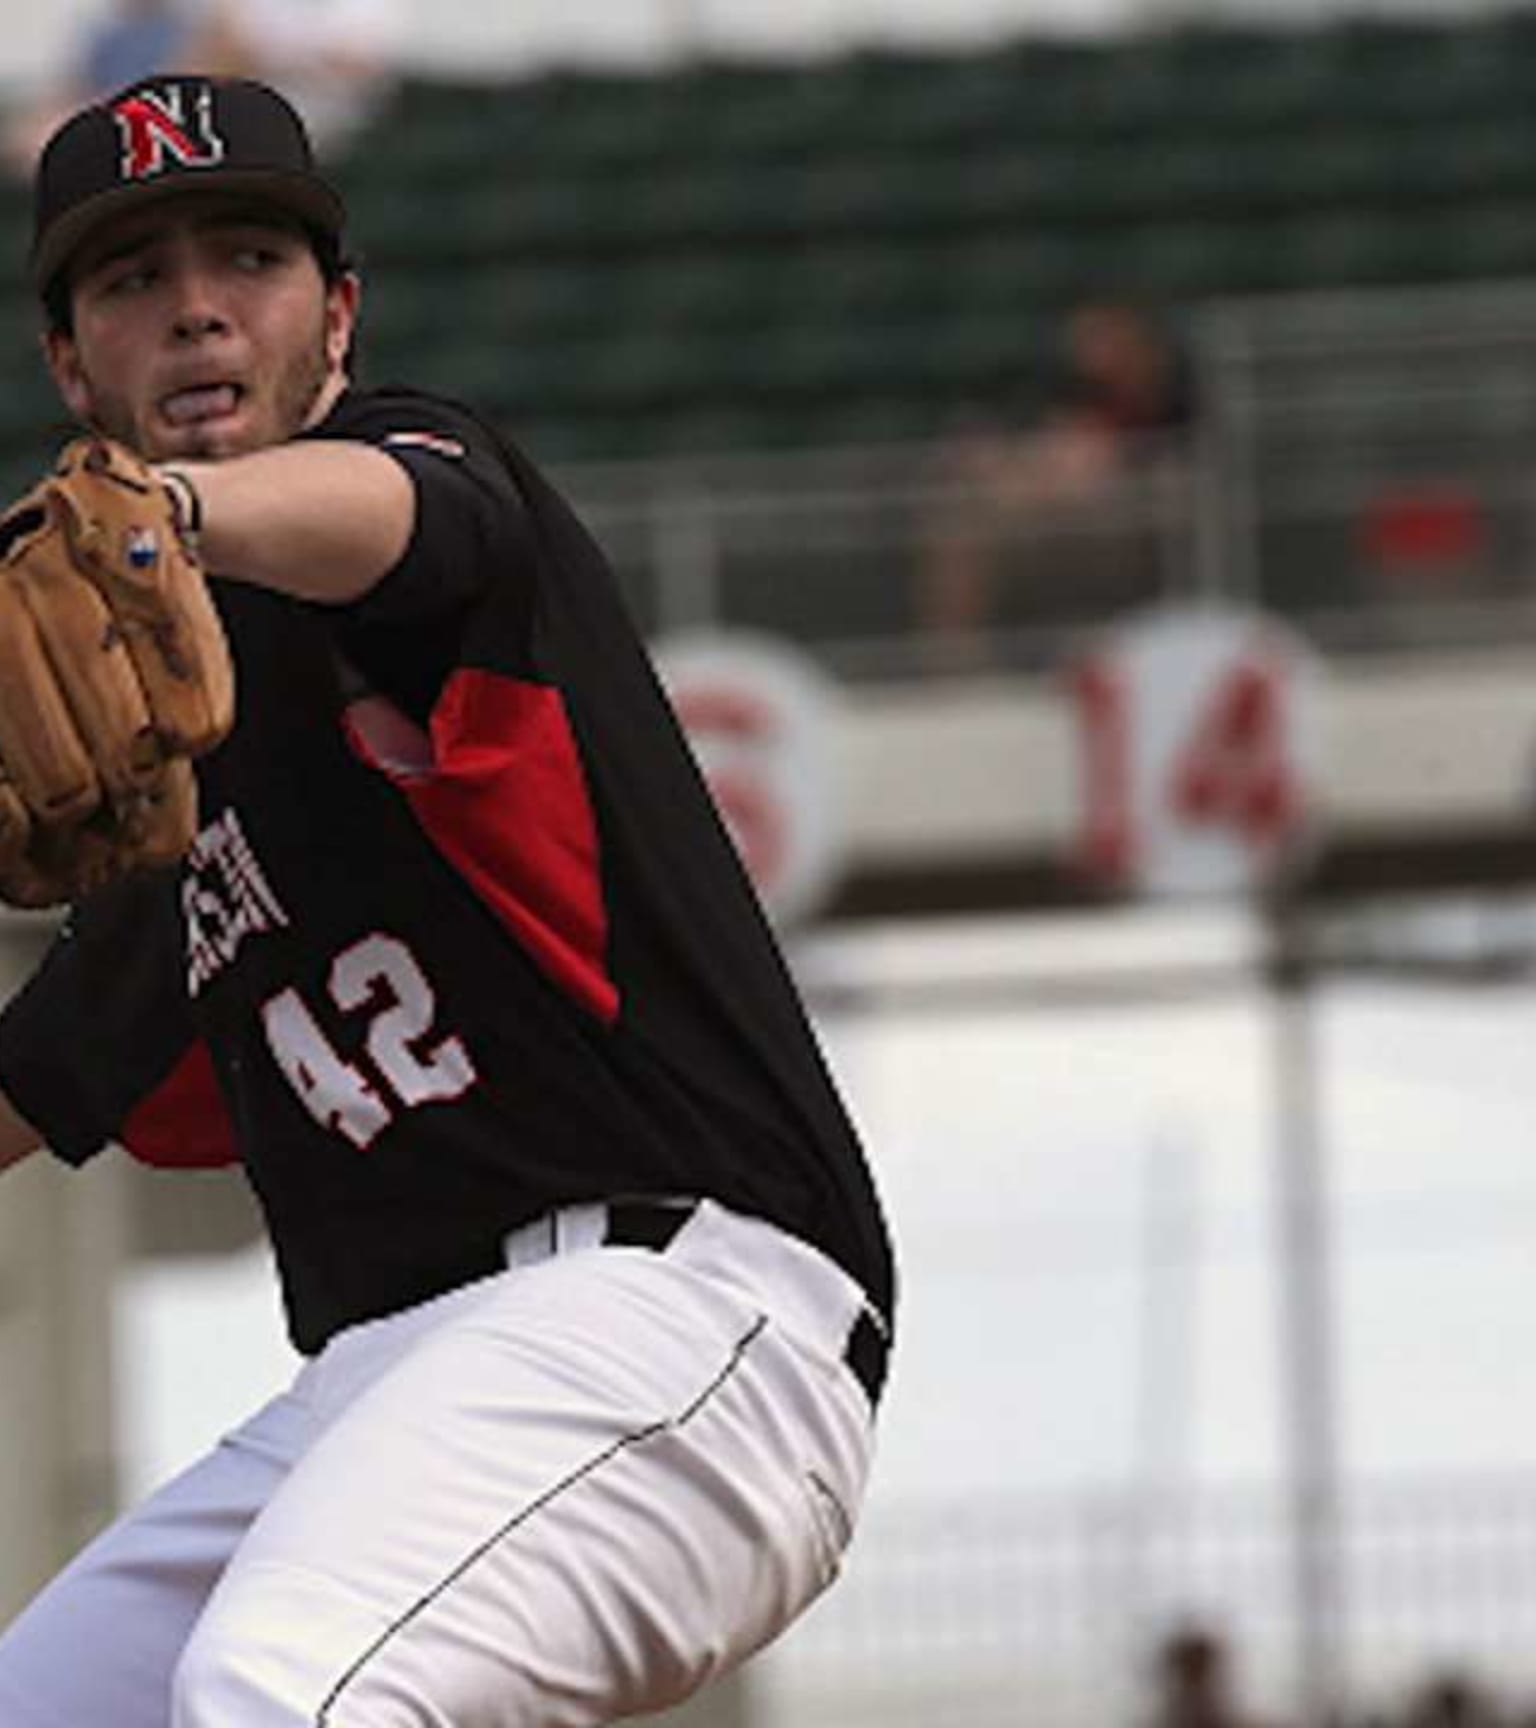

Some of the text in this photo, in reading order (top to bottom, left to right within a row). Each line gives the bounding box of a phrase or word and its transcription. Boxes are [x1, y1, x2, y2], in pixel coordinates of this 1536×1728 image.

[115, 82, 225, 181] N
[1062, 645, 1310, 878] 14
[260, 932, 478, 1152] 42
